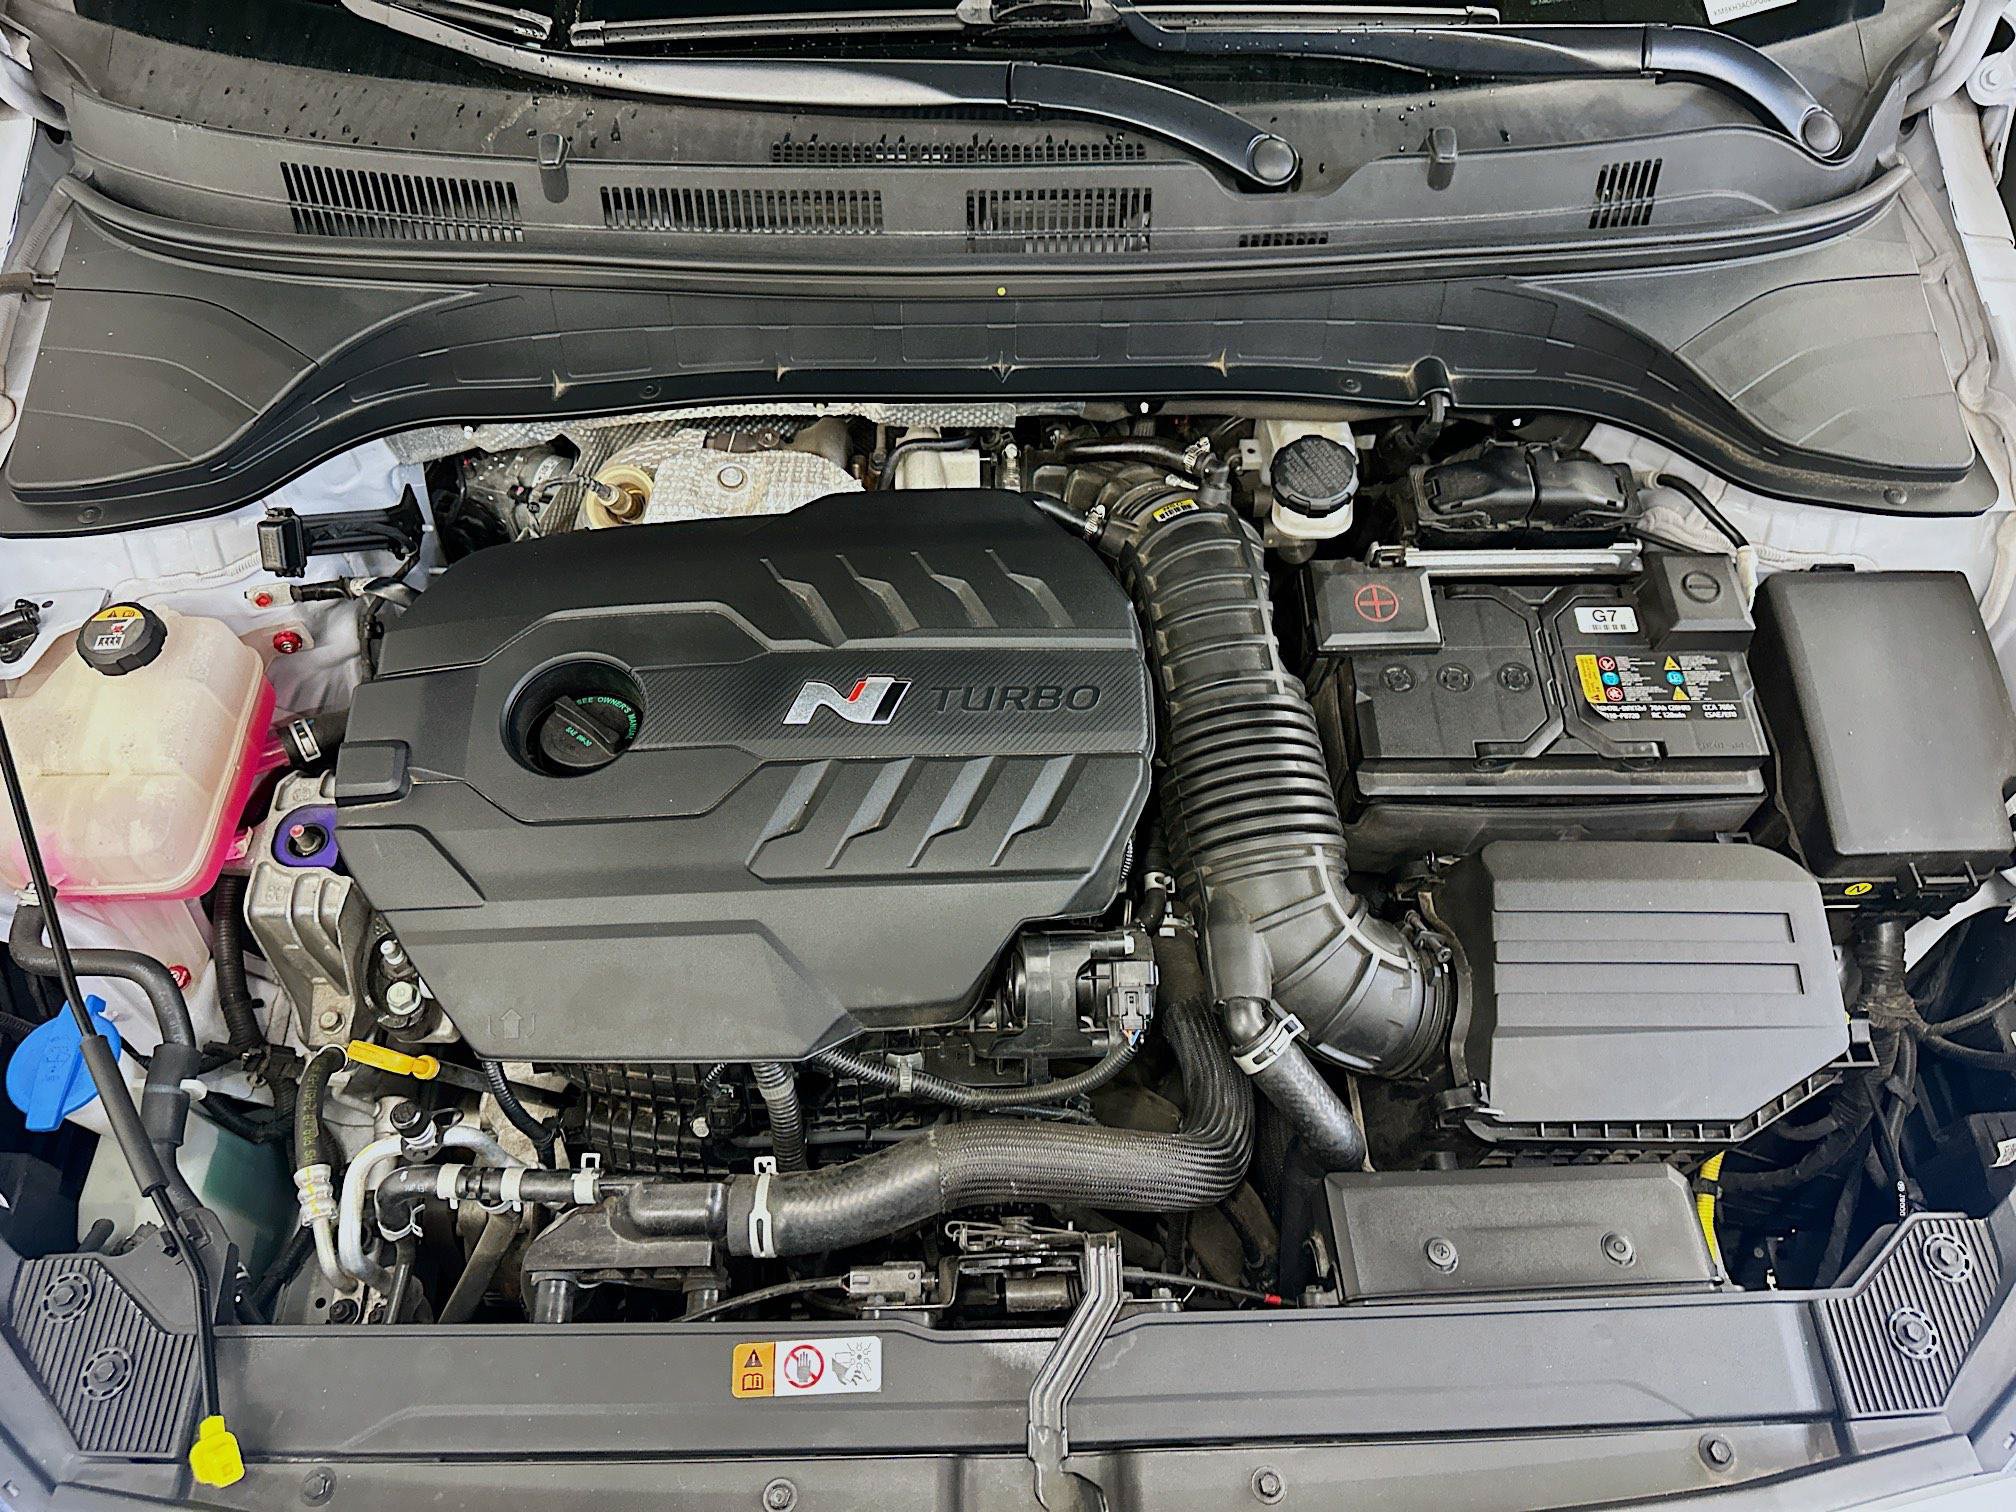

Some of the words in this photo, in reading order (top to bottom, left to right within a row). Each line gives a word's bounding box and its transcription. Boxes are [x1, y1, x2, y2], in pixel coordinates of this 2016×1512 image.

[1592, 609, 1617, 622] G7
[576, 696, 594, 705] SEE
[597, 696, 632, 713] OWNER'S
[931, 684, 1102, 713] TURBO
